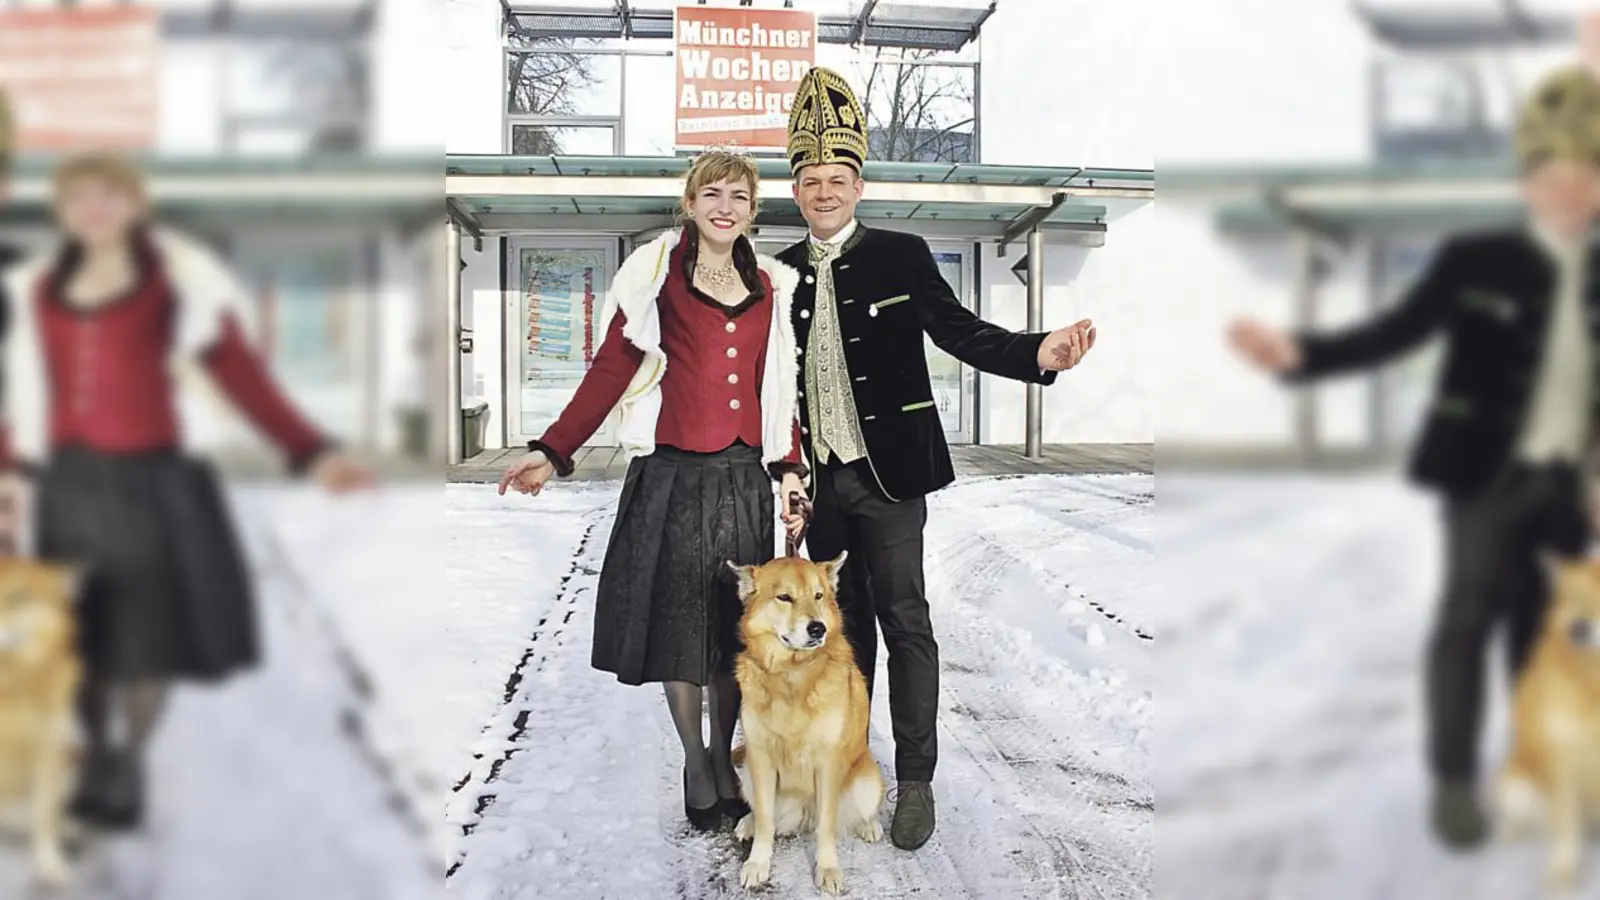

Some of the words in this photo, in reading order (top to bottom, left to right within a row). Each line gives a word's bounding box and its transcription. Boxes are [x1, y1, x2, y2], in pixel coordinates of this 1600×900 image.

[679, 20, 811, 47] Münchner
[679, 49, 811, 82] Wochen
[679, 84, 795, 116] Anzeige
